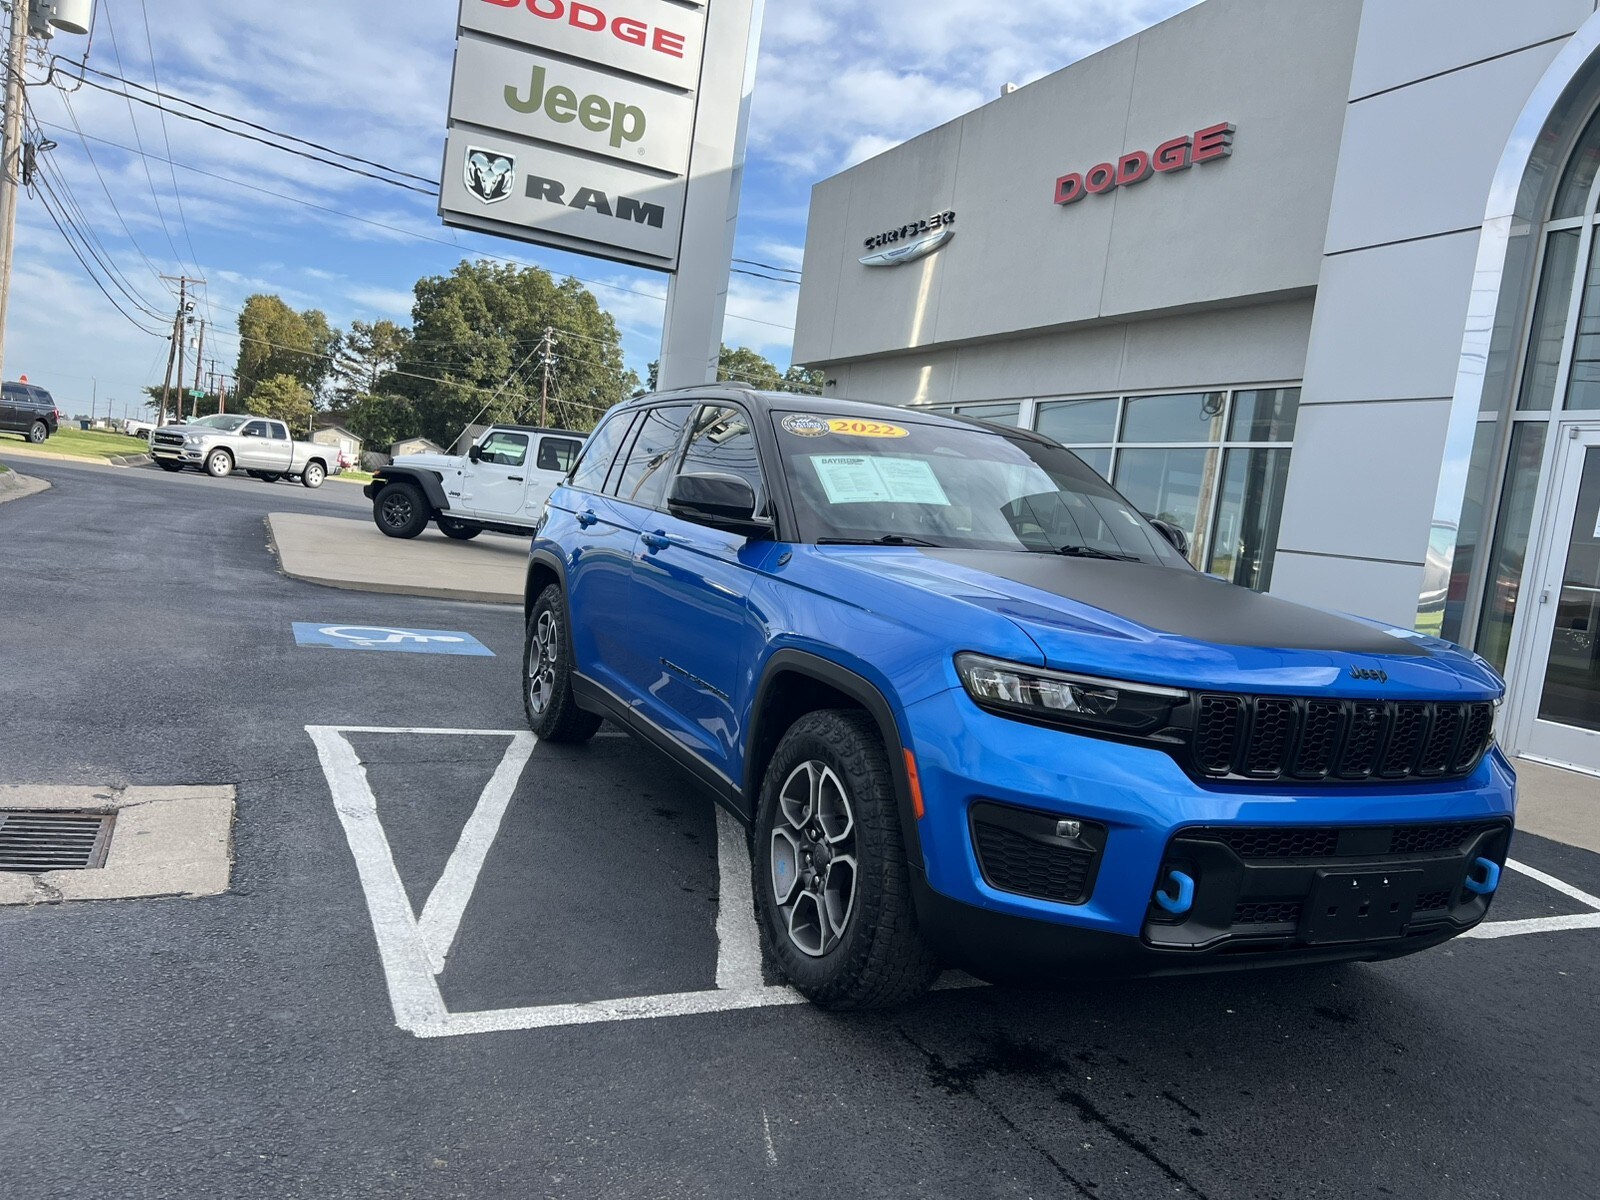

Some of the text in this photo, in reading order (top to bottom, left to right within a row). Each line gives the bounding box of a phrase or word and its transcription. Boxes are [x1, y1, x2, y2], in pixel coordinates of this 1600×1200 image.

[504, 65, 646, 148] Jeep
[1054, 121, 1235, 206] DODGE
[525, 174, 665, 229] RAM
[864, 209, 956, 250] CHRYSLER
[834, 421, 896, 436] 2022
[1349, 663, 1388, 684] Jeep
